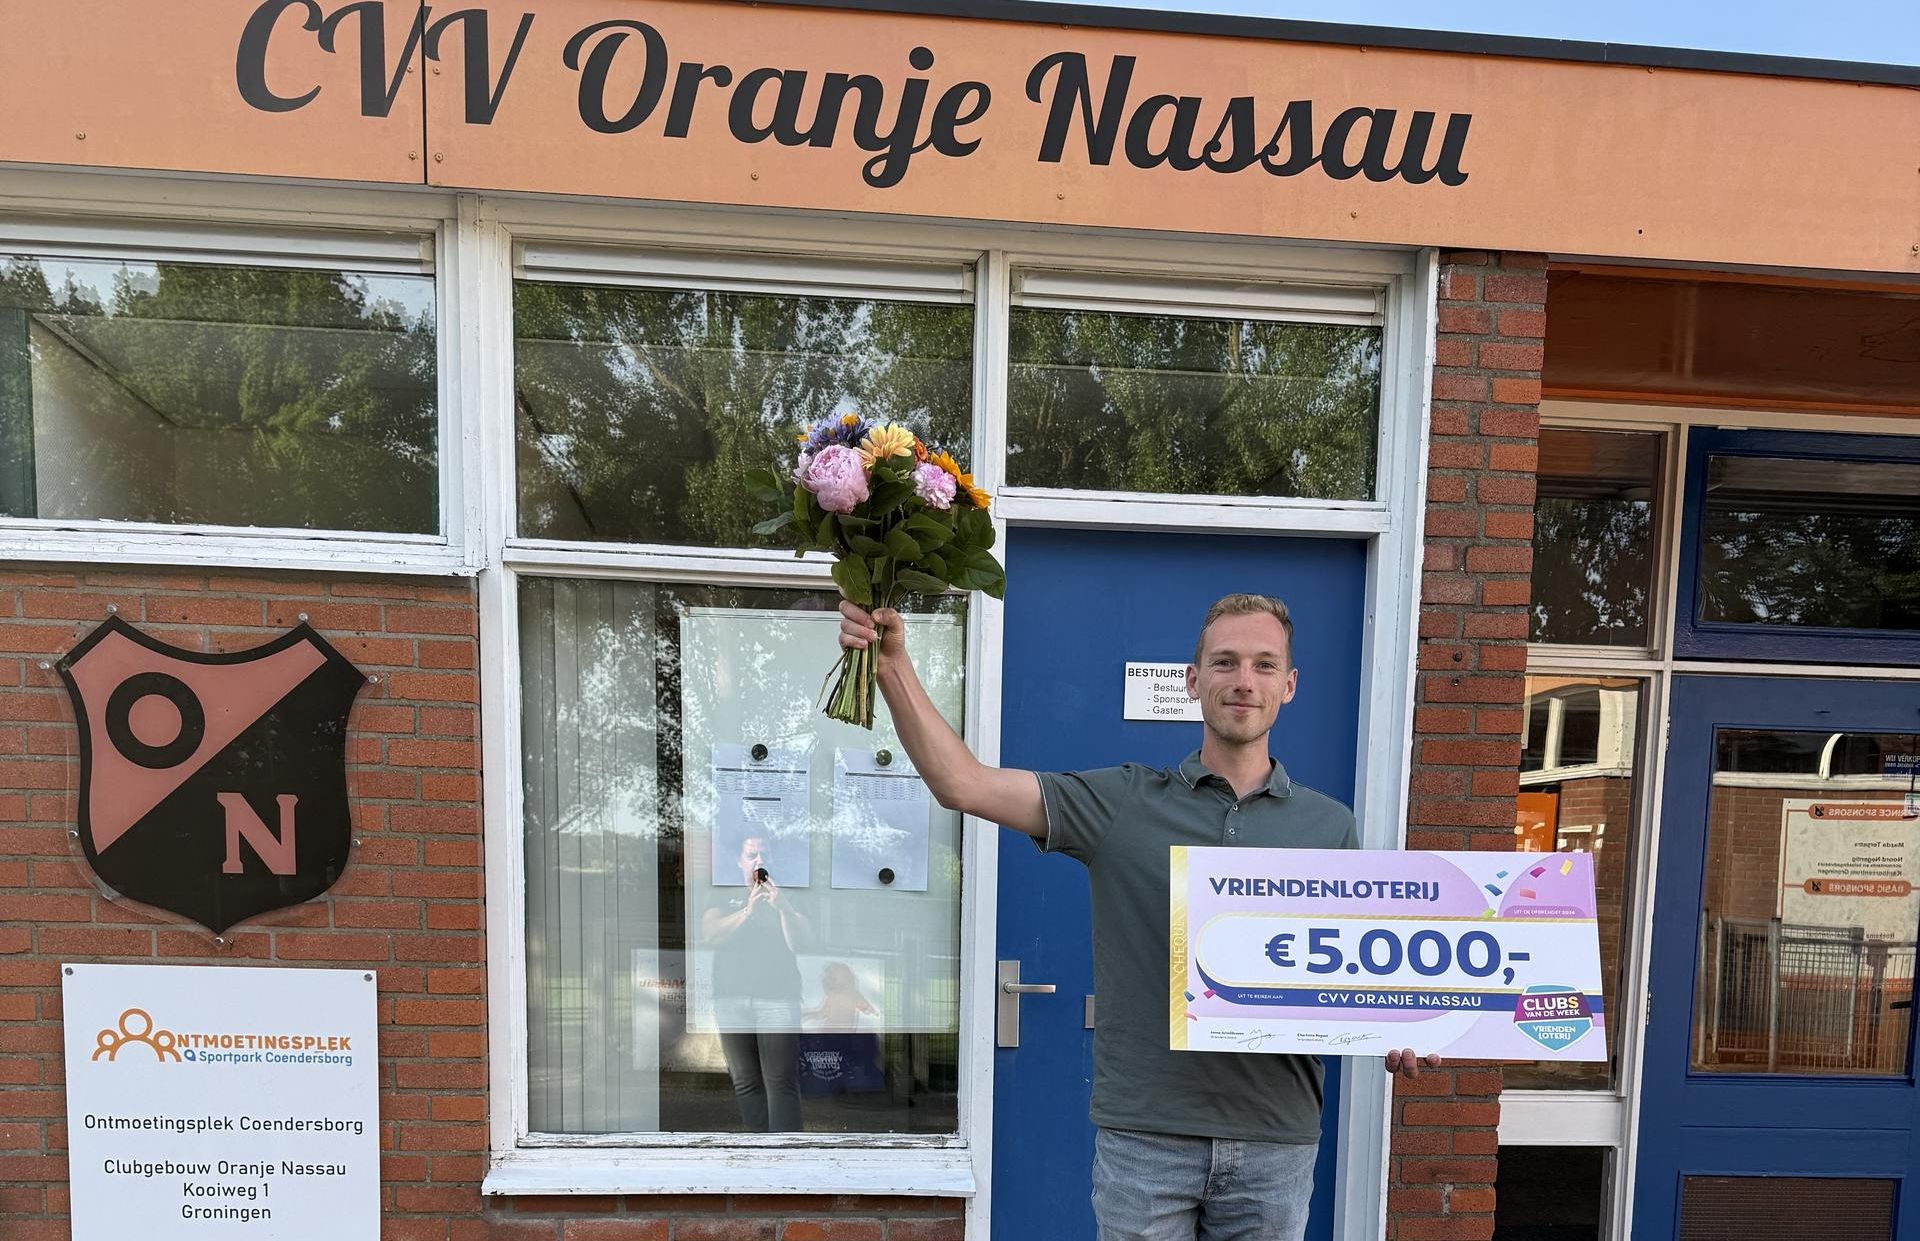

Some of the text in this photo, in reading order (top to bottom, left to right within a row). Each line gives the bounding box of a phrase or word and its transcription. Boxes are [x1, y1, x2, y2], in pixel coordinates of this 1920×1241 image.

[236, 0, 1473, 188] CVV Oranje Nassau
[1128, 668, 1185, 679] BESTUURS
[1153, 695, 1200, 705] Sponsoren
[1152, 706, 1184, 715] Gasten
[217, 792, 299, 875] N
[1208, 877, 1440, 902] VRIENDENLOTERIJ
[1306, 928, 1531, 985] 5.000,-
[1317, 992, 1482, 1007] CVV ORANJE NASSAU
[1523, 996, 1579, 1011] CLUBS
[1533, 1025, 1576, 1033] VRIENDEN
[1538, 1032, 1571, 1040] LOTERIJ
[199, 1051, 353, 1066] Sportpark Coendersborg
[84, 1114, 364, 1135] Ontmoetingsplek Coendersborg
[104, 1160, 347, 1179] Clubgebouw Oranje Nassau
[183, 1182, 270, 1200] Kooiweg 1
[181, 1204, 272, 1223] Groningen
